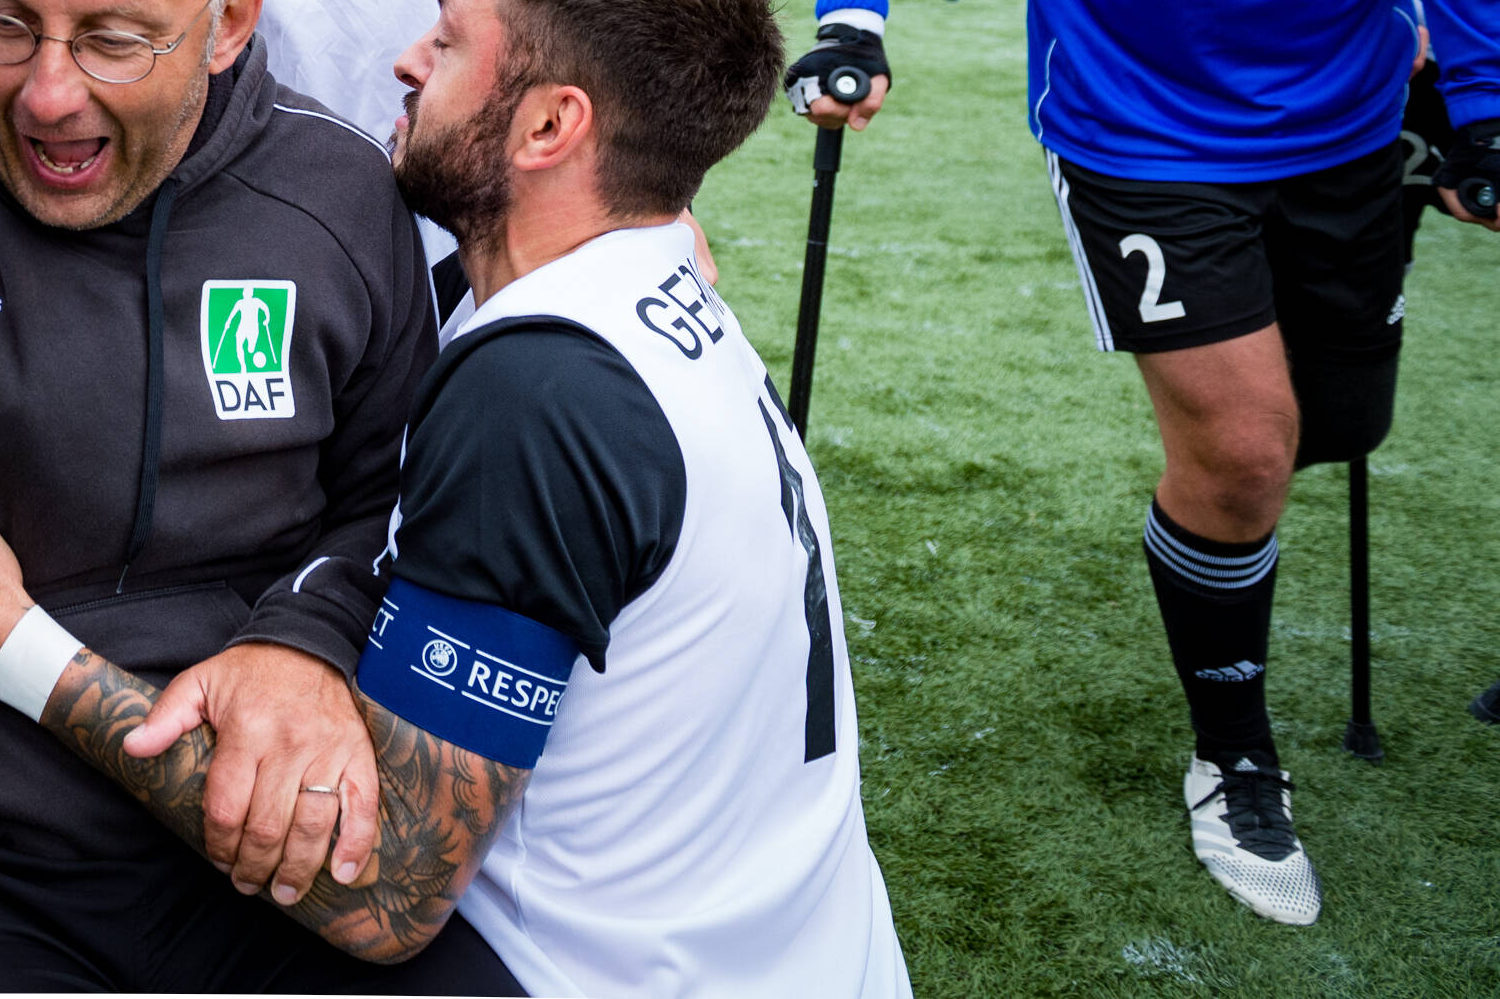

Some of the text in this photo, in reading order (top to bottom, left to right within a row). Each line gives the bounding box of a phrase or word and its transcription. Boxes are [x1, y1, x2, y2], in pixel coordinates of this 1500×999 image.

[1118, 232, 1187, 324] 2
[215, 377, 285, 412] DAF
[466, 659, 565, 717] RESPE
